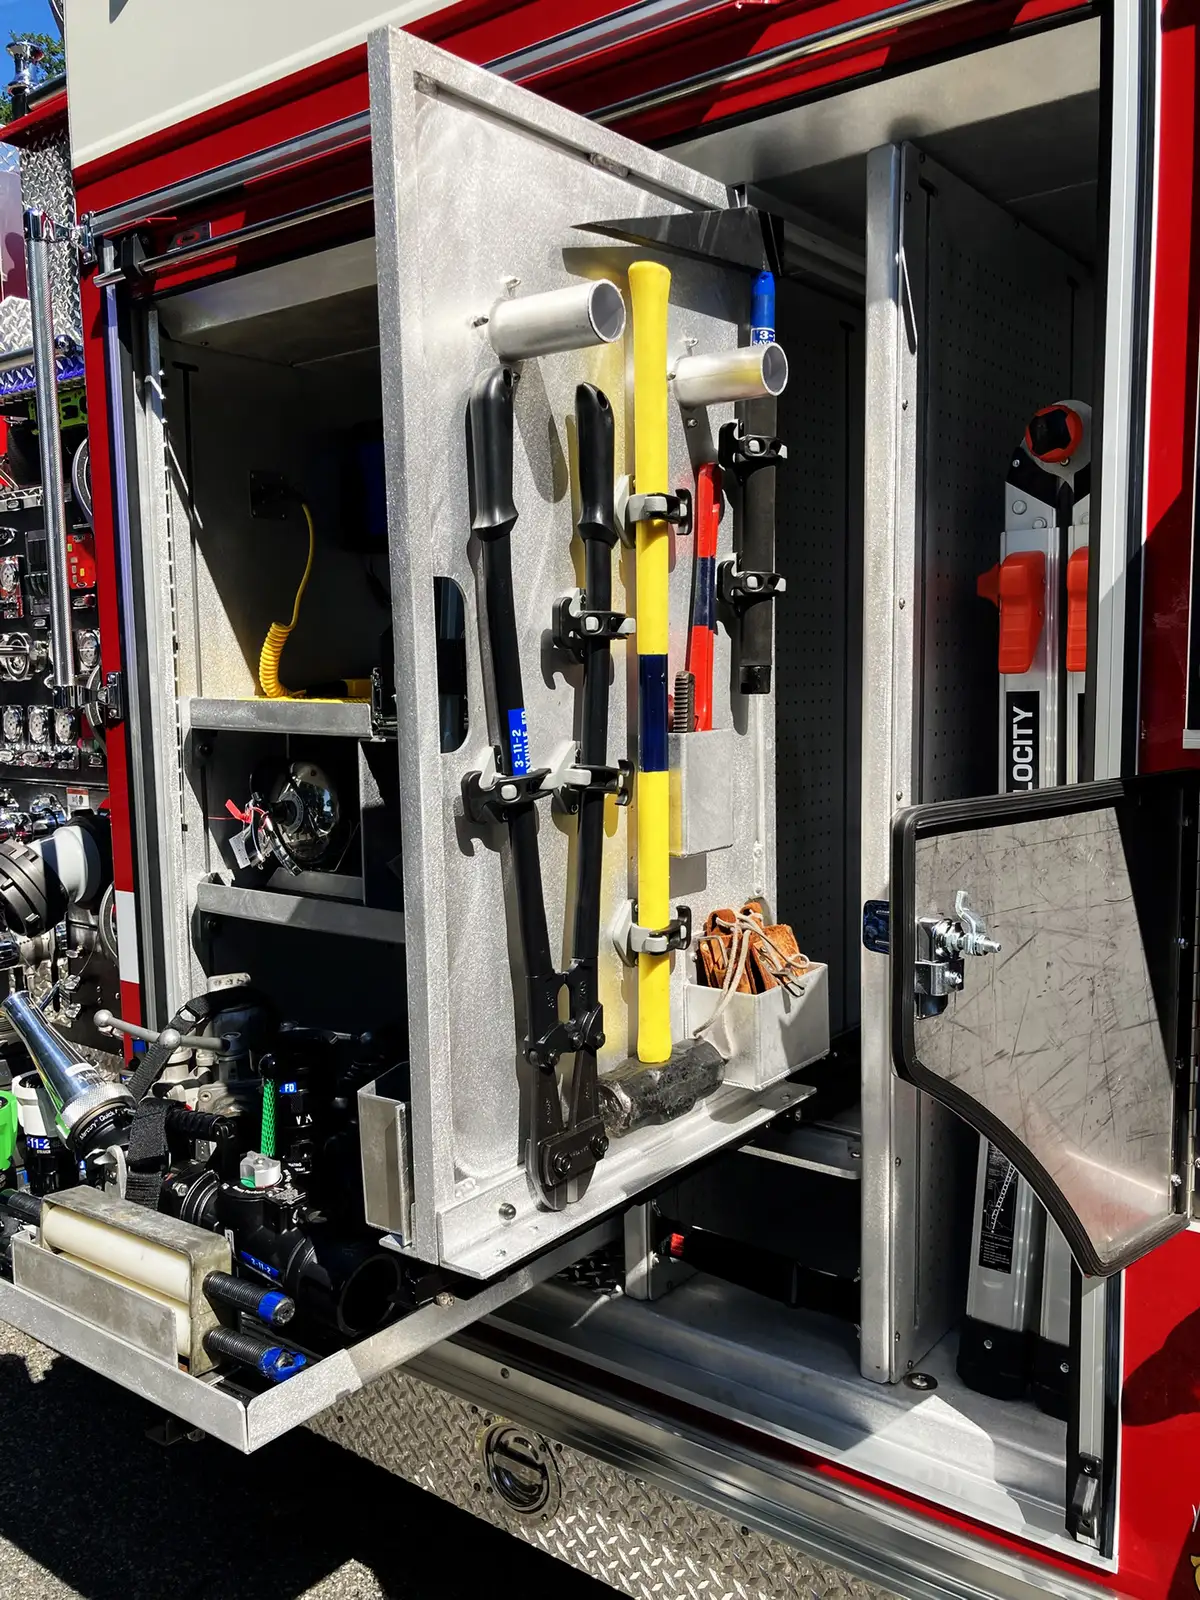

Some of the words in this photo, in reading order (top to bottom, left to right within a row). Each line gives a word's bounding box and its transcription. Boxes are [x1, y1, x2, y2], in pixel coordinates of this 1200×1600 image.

[512, 729, 524, 768] 3-11-2
[285, 1083, 295, 1093] FD
[99, 1110, 116, 1122] Quick
